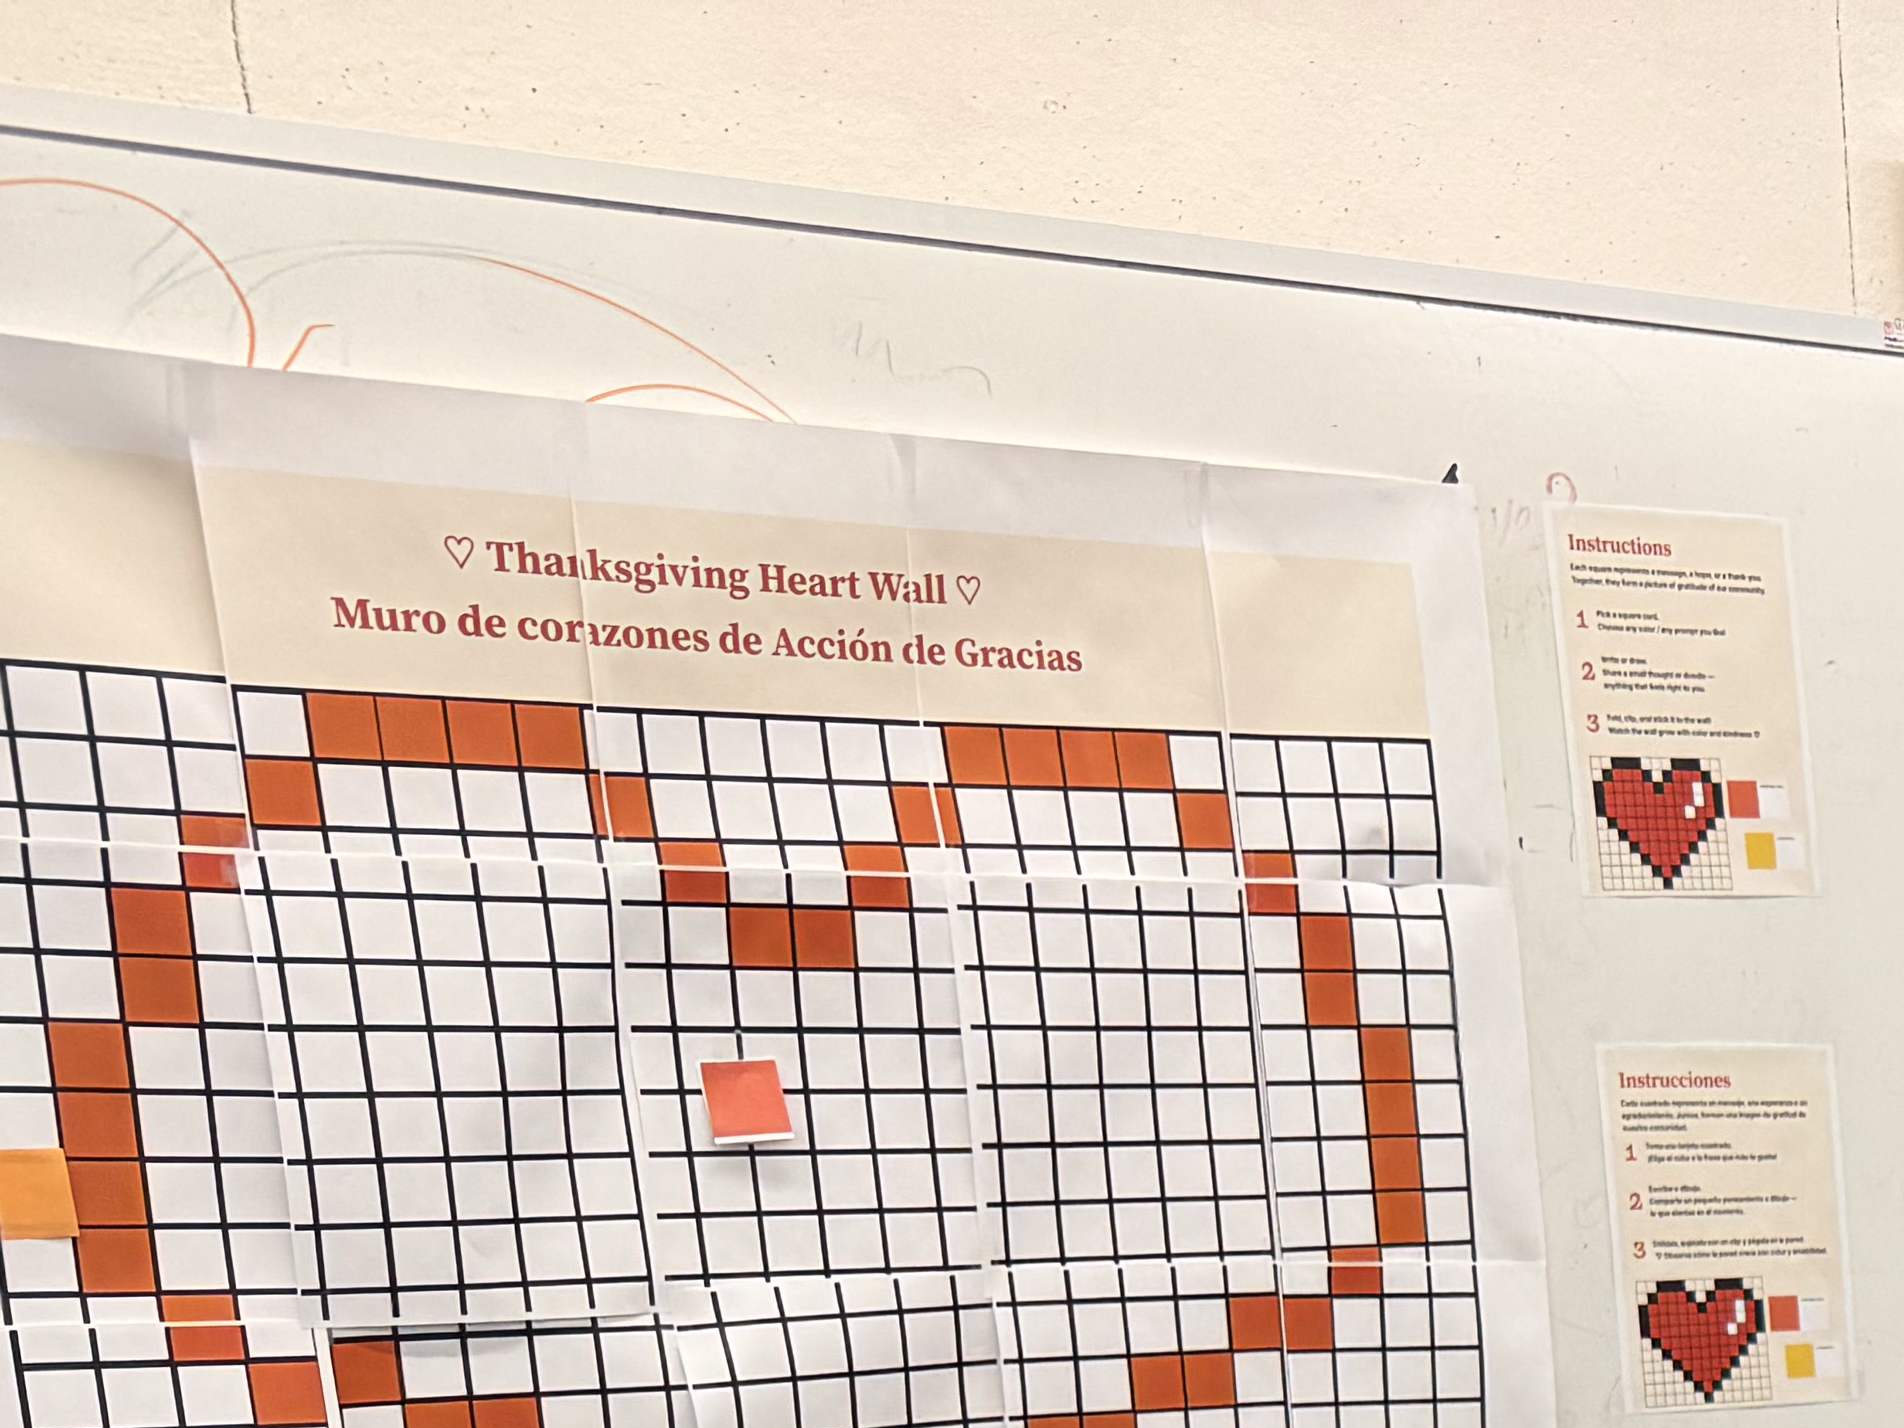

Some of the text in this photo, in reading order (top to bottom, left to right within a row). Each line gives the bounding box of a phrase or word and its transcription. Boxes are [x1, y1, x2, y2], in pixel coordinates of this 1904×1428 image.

[1568, 534, 1672, 556] Instructions
[486, 540, 947, 605] Thanksgiving Heart Wall
[1577, 610, 1588, 629] 1
[332, 598, 1083, 673] Muro de corazones de Acción de Gracias
[1582, 662, 1595, 680] 2
[1587, 714, 1600, 732] 3
[1619, 1071, 1731, 1088] Instrucciones
[1626, 1144, 1637, 1161] 1
[1629, 1193, 1643, 1210] 2
[1633, 1242, 1646, 1259] 3
